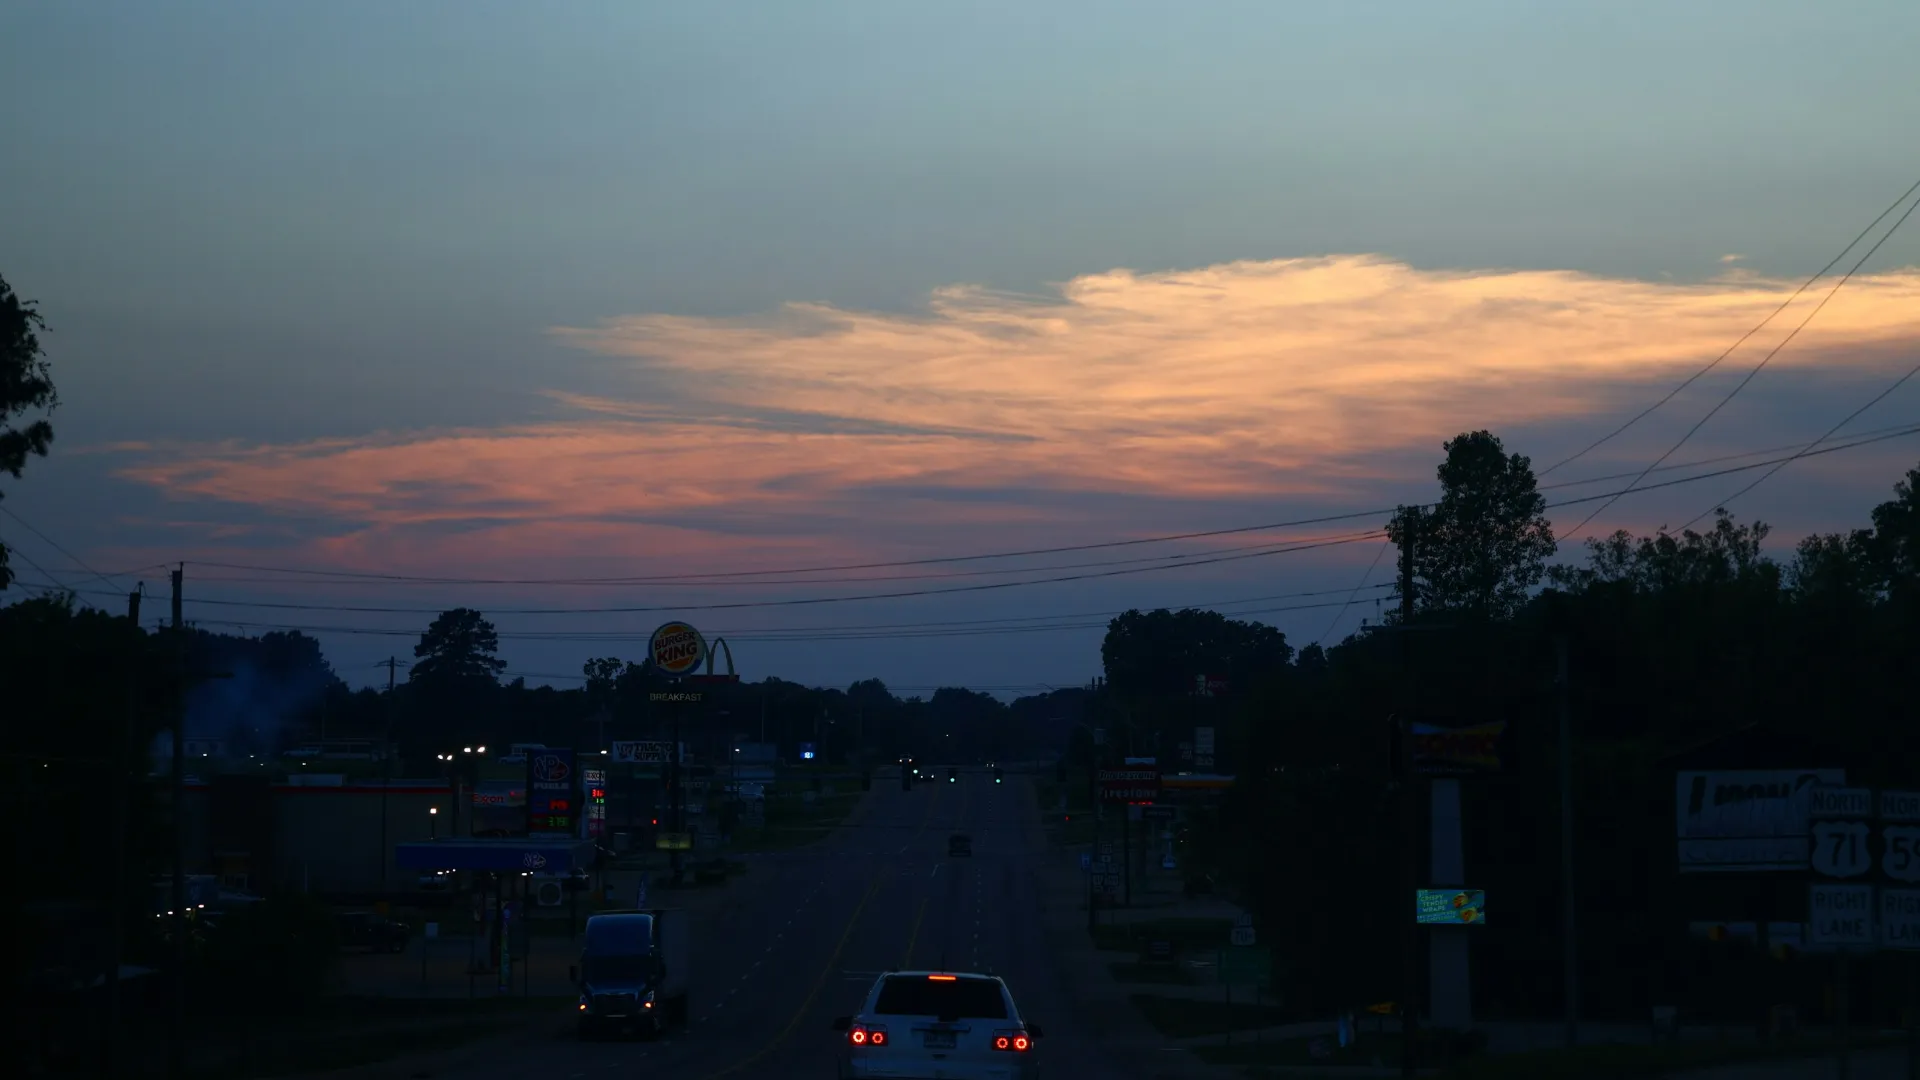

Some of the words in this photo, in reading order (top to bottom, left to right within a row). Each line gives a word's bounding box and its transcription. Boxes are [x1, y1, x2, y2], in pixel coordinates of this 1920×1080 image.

[655, 631, 696, 650] BURGER
[656, 642, 698, 665] KING
[649, 693, 703, 702] BREAKFAST
[633, 743, 675, 752] TRACTO
[1813, 791, 1870, 812] NORTH
[1828, 832, 1857, 867] 71
[1423, 899, 1448, 907] TENDER
[1815, 891, 1868, 911] RIGHT
[1820, 918, 1864, 938] LANE
